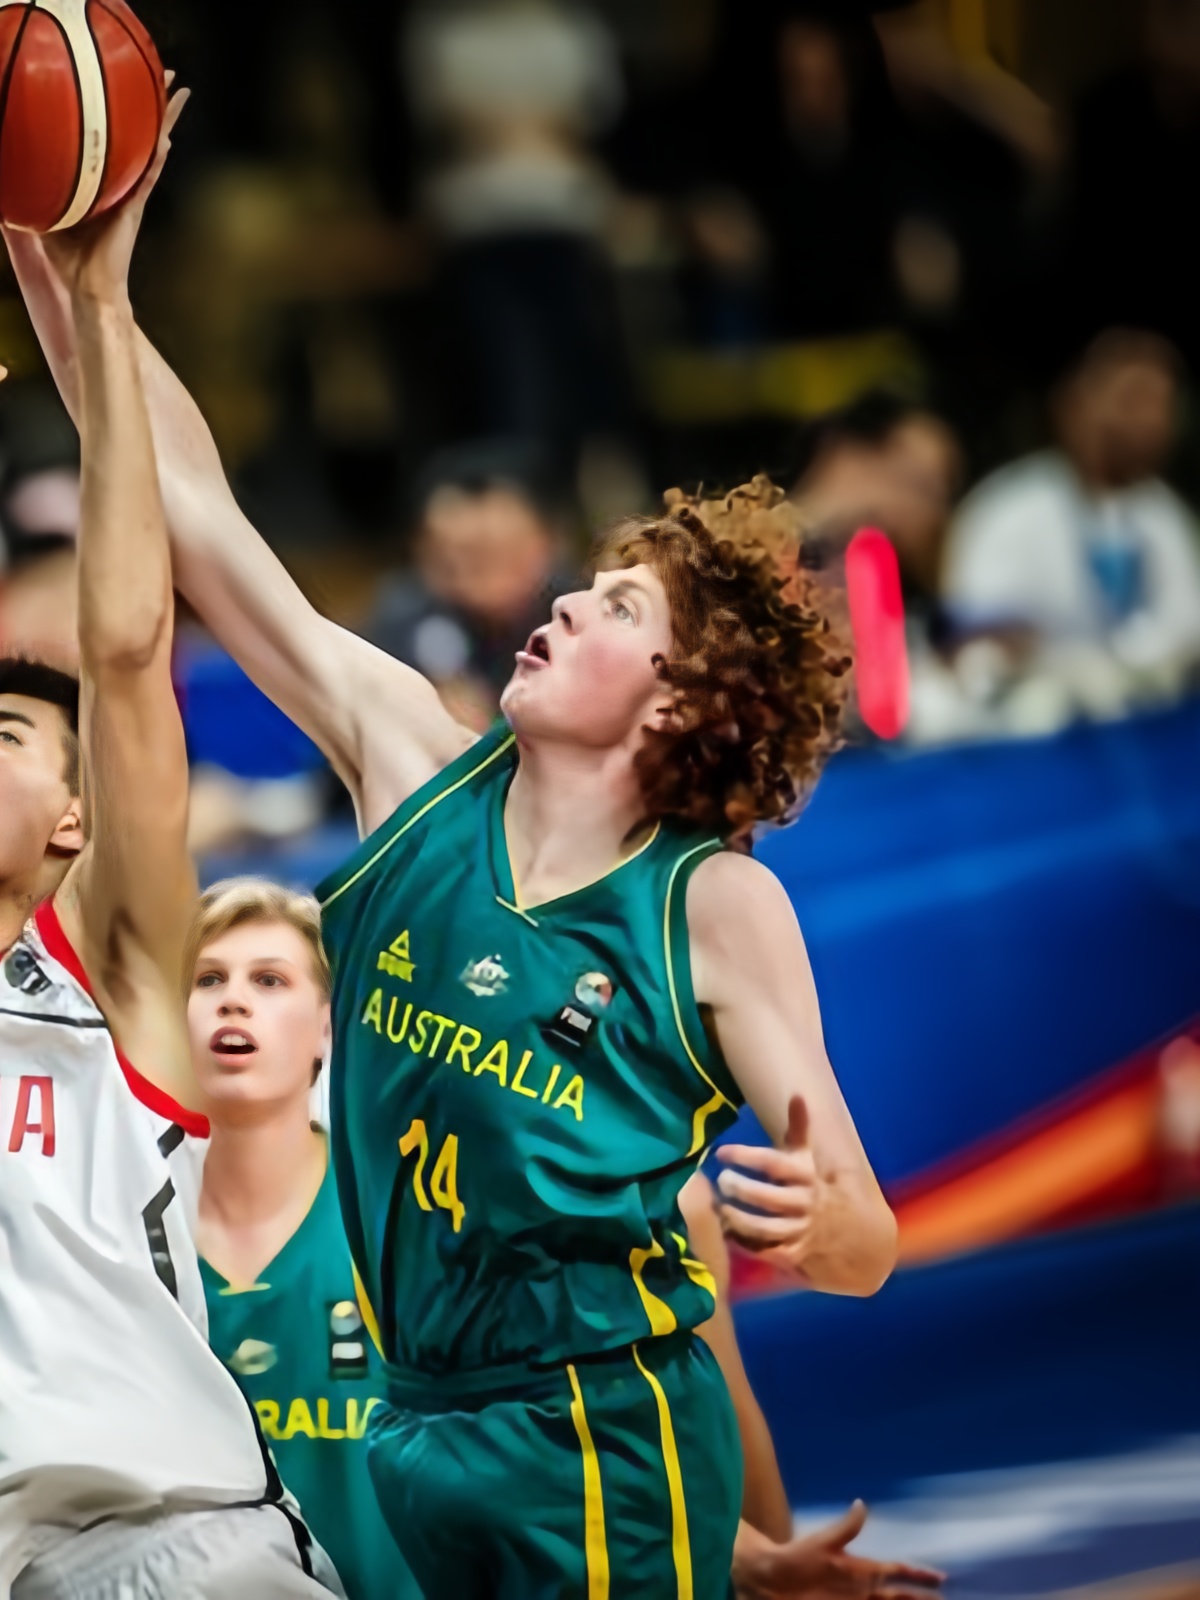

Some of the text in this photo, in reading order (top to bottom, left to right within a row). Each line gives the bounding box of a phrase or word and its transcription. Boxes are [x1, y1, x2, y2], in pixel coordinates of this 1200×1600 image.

[361, 988, 584, 1121] AUSTRALIA
[399, 1119, 465, 1233] 14
[254, 1397, 383, 1440] RALI
